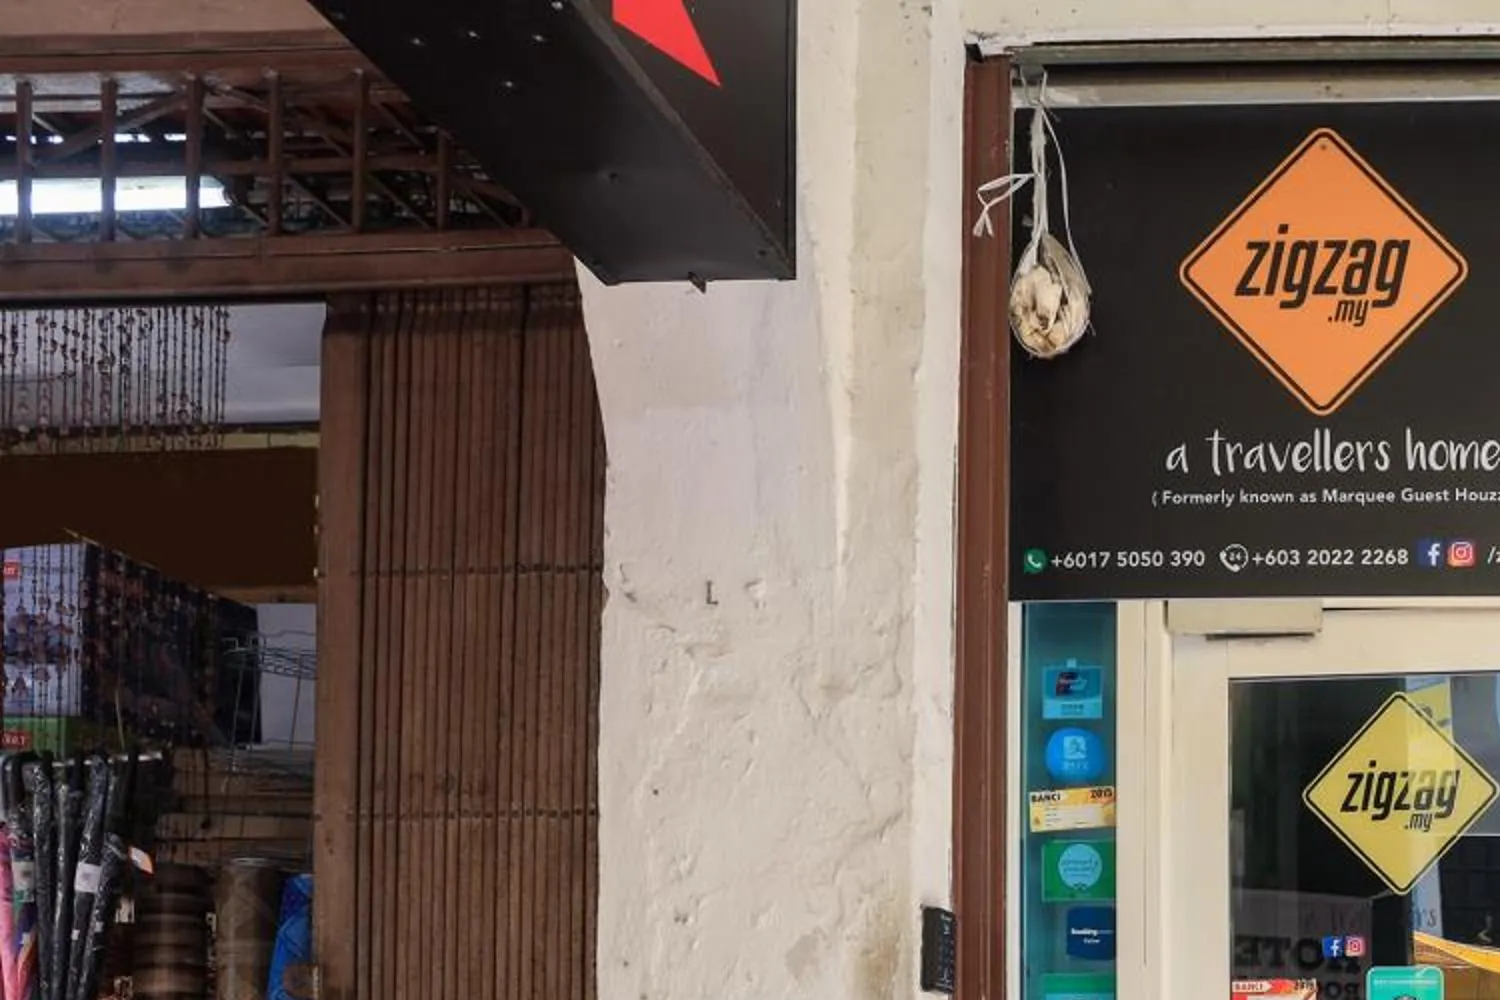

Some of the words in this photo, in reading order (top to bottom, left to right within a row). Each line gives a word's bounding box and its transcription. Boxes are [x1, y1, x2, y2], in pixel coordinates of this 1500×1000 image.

[1234, 224, 1411, 309] zigzag
[1328, 298, 1369, 327] .my
[1165, 443, 1189, 473] a
[1204, 428, 1391, 476] travellers
[1240, 488, 1294, 503] known
[1299, 491, 1317, 503] as
[1322, 488, 1395, 507] Marquee
[1401, 487, 1450, 502] Guest
[1051, 551, 1111, 568] +6017
[1116, 551, 1164, 568] 5050
[1170, 550, 1205, 567] 390
[1252, 549, 1301, 566] +603
[1307, 549, 1354, 566] 2022
[1361, 548, 1408, 566] 2268
[1340, 760, 1461, 821] zigzag
